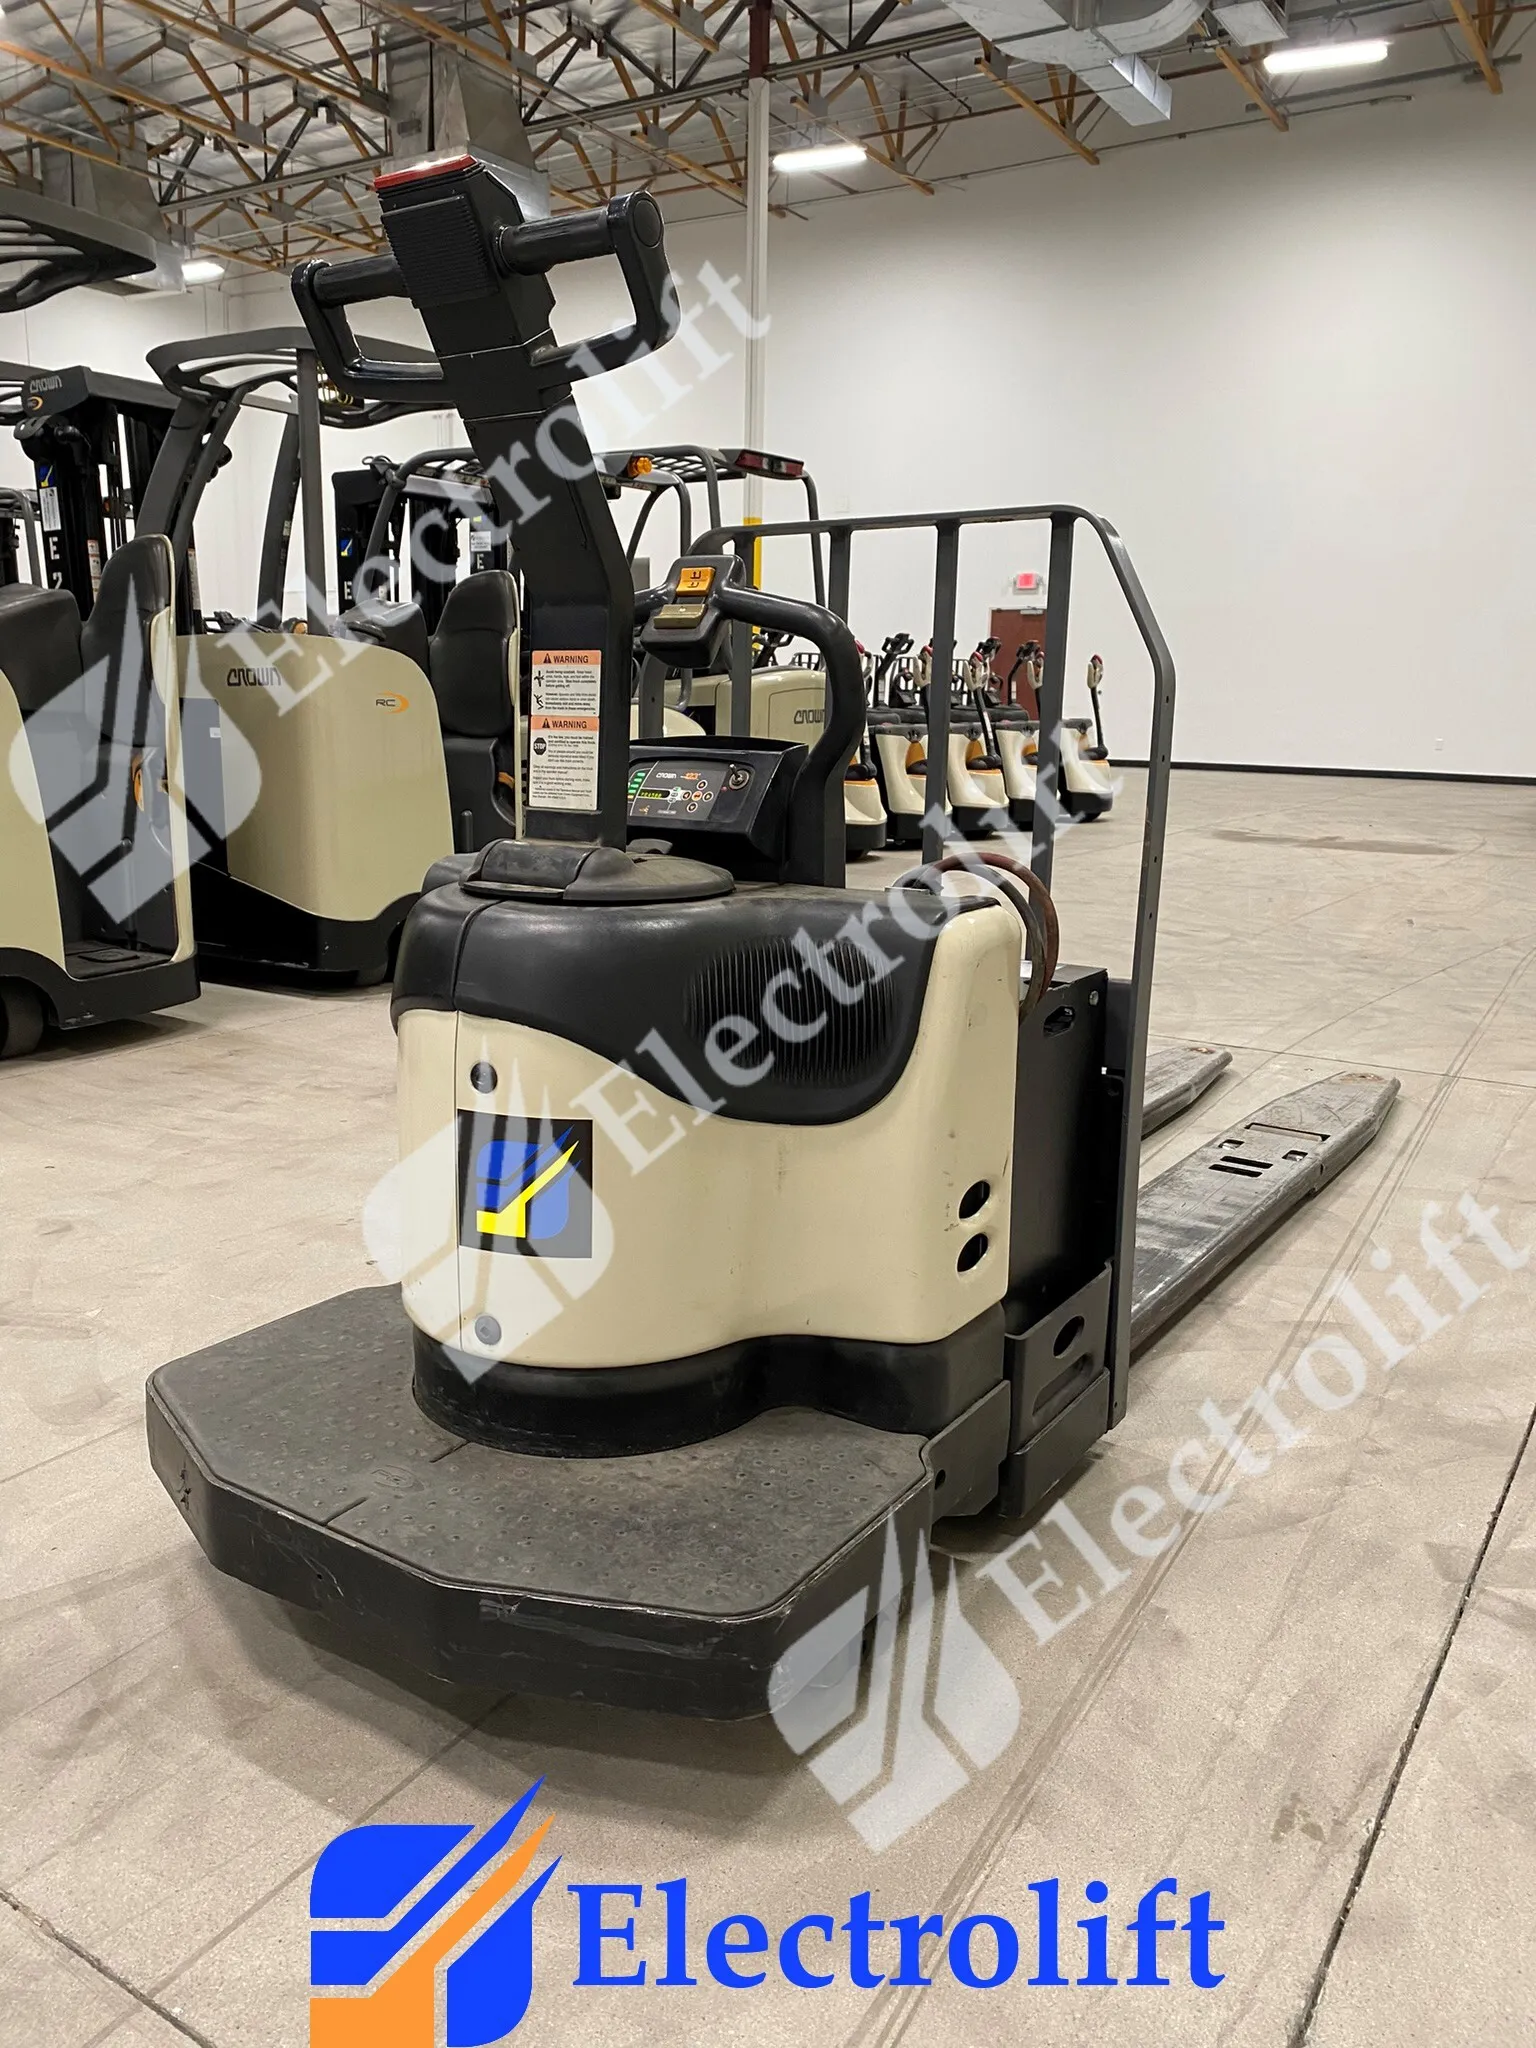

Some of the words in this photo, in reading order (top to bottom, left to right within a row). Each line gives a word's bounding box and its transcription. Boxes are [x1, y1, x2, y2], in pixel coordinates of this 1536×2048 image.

[30, 375, 62, 393] CROWN
[553, 655, 589, 664] WARNING
[226, 667, 282, 687] CROWN
[375, 699, 396, 707] RC
[552, 720, 588, 729] WARNING
[534, 742, 546, 750] STOP
